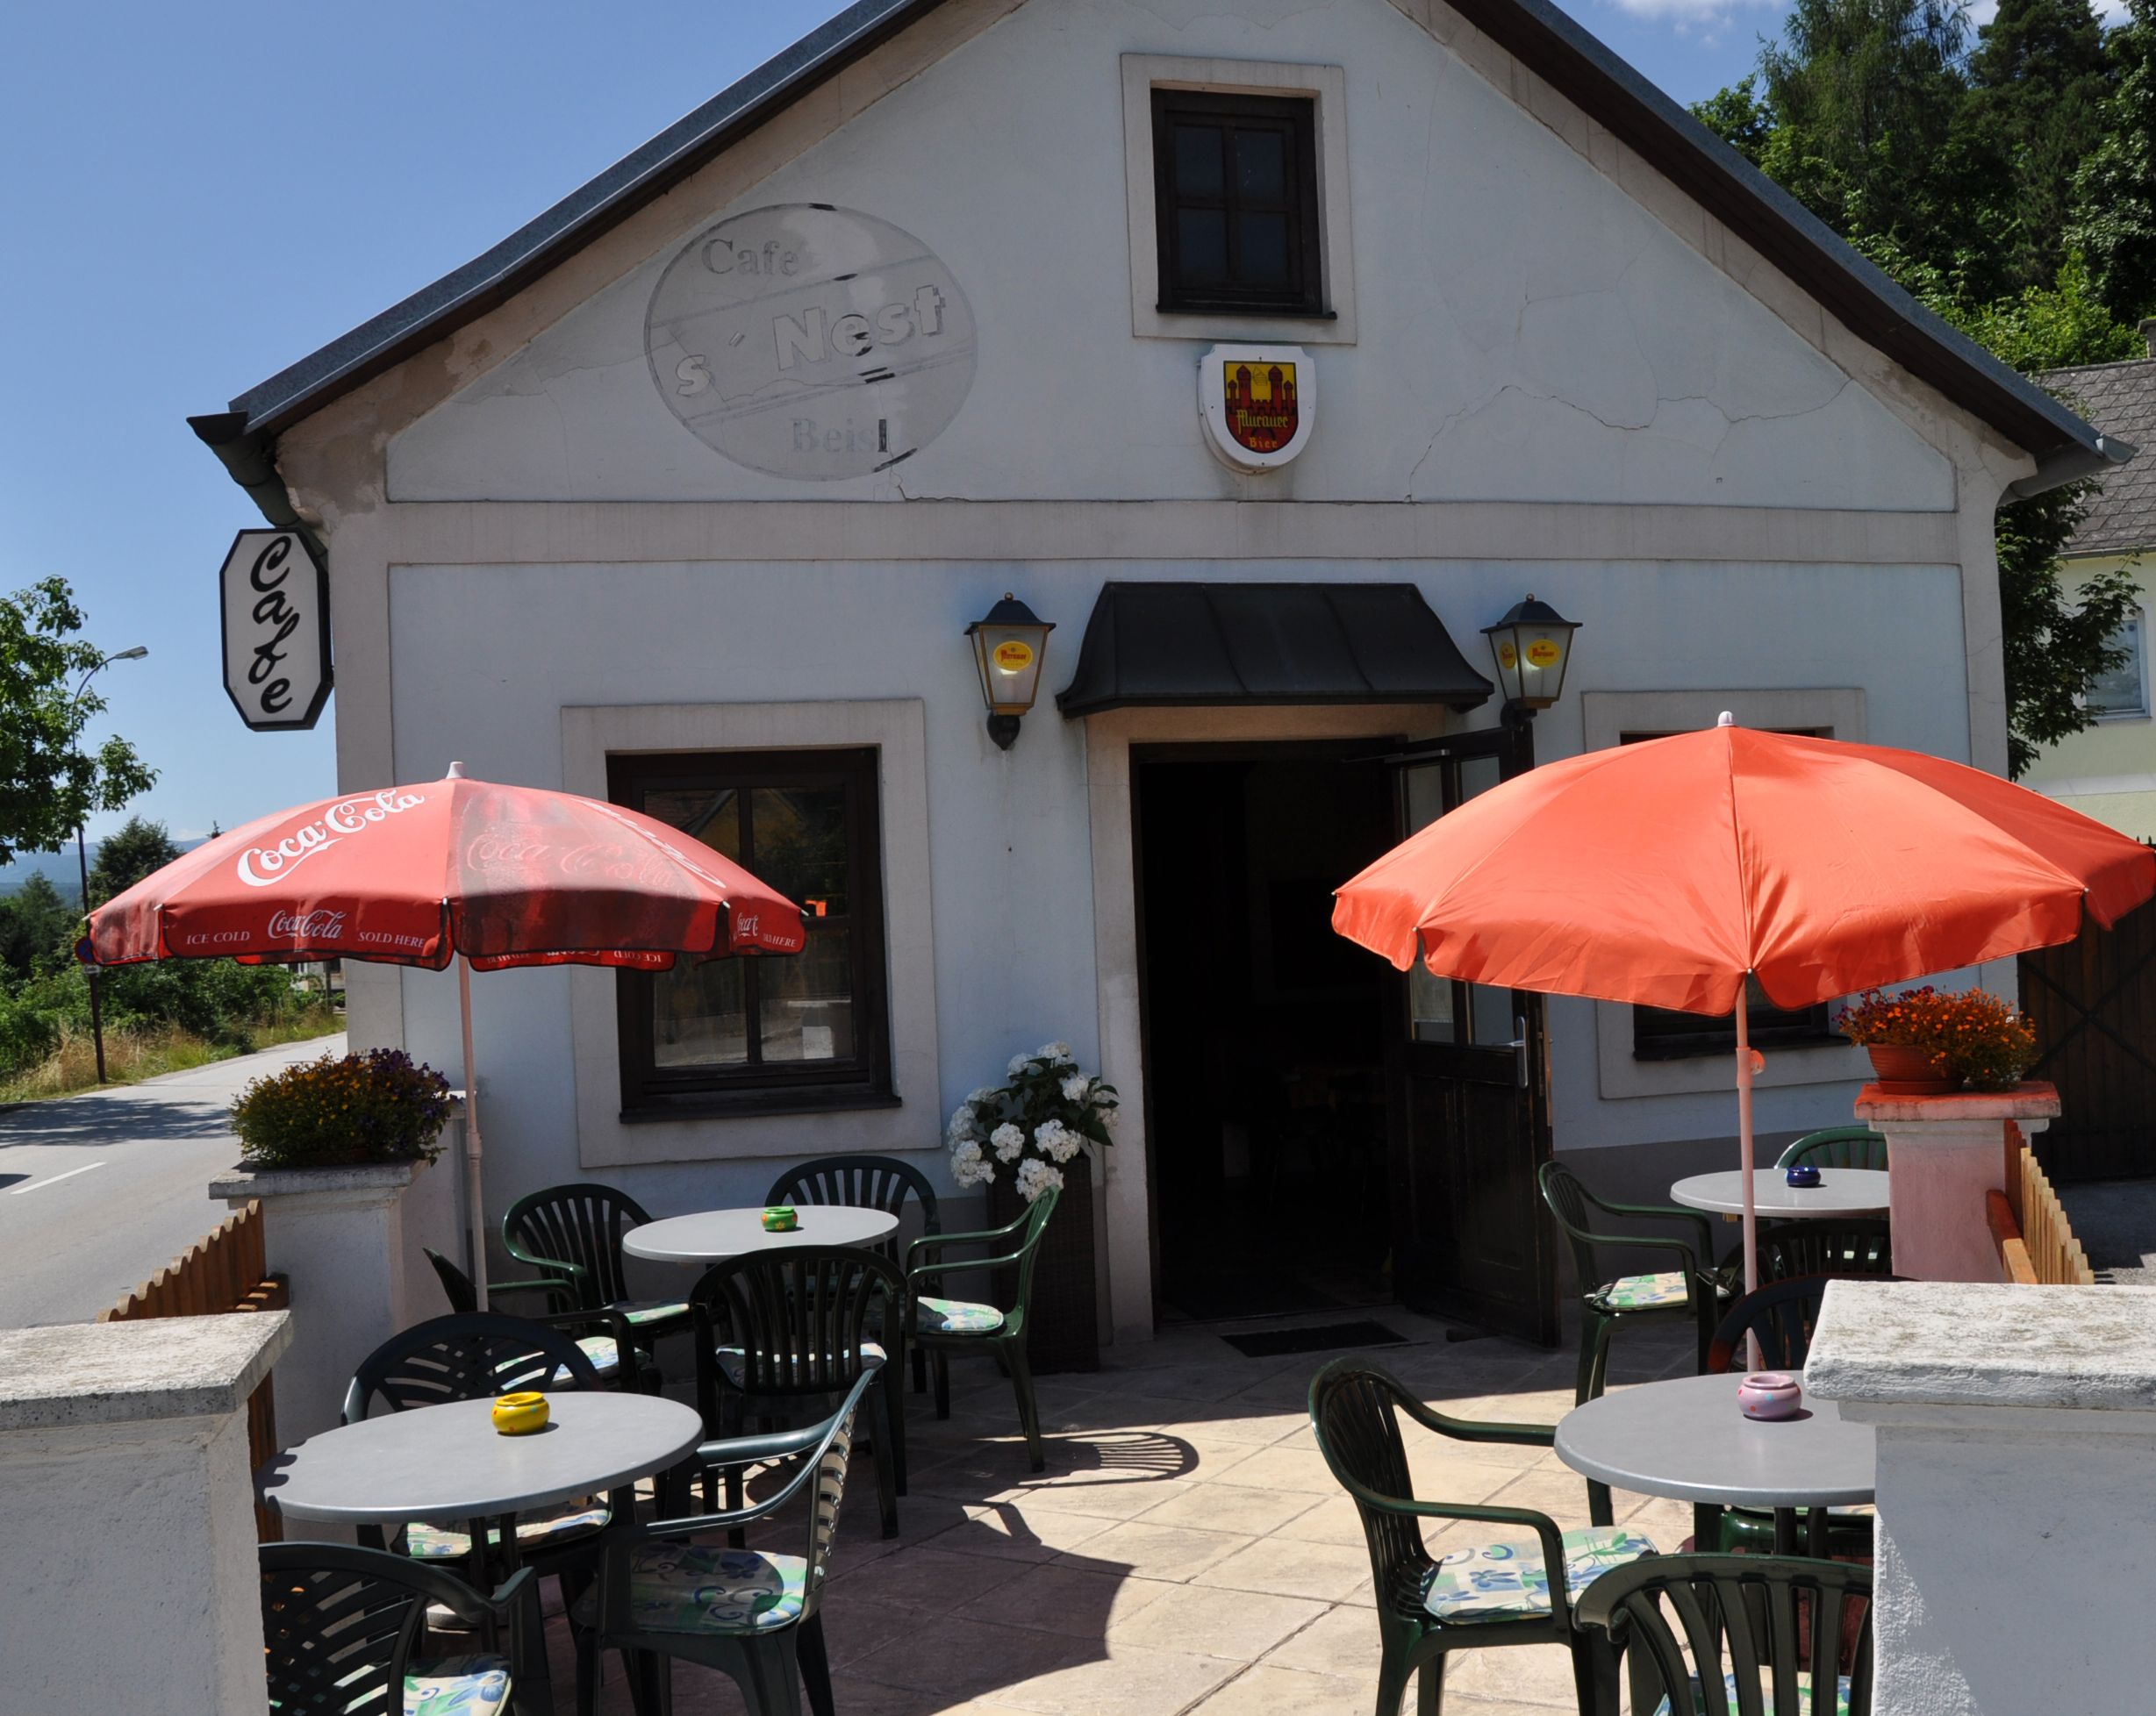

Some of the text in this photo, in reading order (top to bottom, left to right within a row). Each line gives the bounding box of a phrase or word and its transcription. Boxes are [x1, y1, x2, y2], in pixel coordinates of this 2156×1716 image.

[702, 238, 800, 277] Cafe
[772, 283, 945, 371] Nest
[792, 418, 888, 453] Beisl
[1236, 409, 1289, 435] Murauer
[247, 535, 301, 714] Cafe
[237, 788, 425, 887] Coca-Cola
[186, 909, 426, 949] ICE COLD Coca-Cola SOLD HERE
[772, 934, 798, 947] HERE
